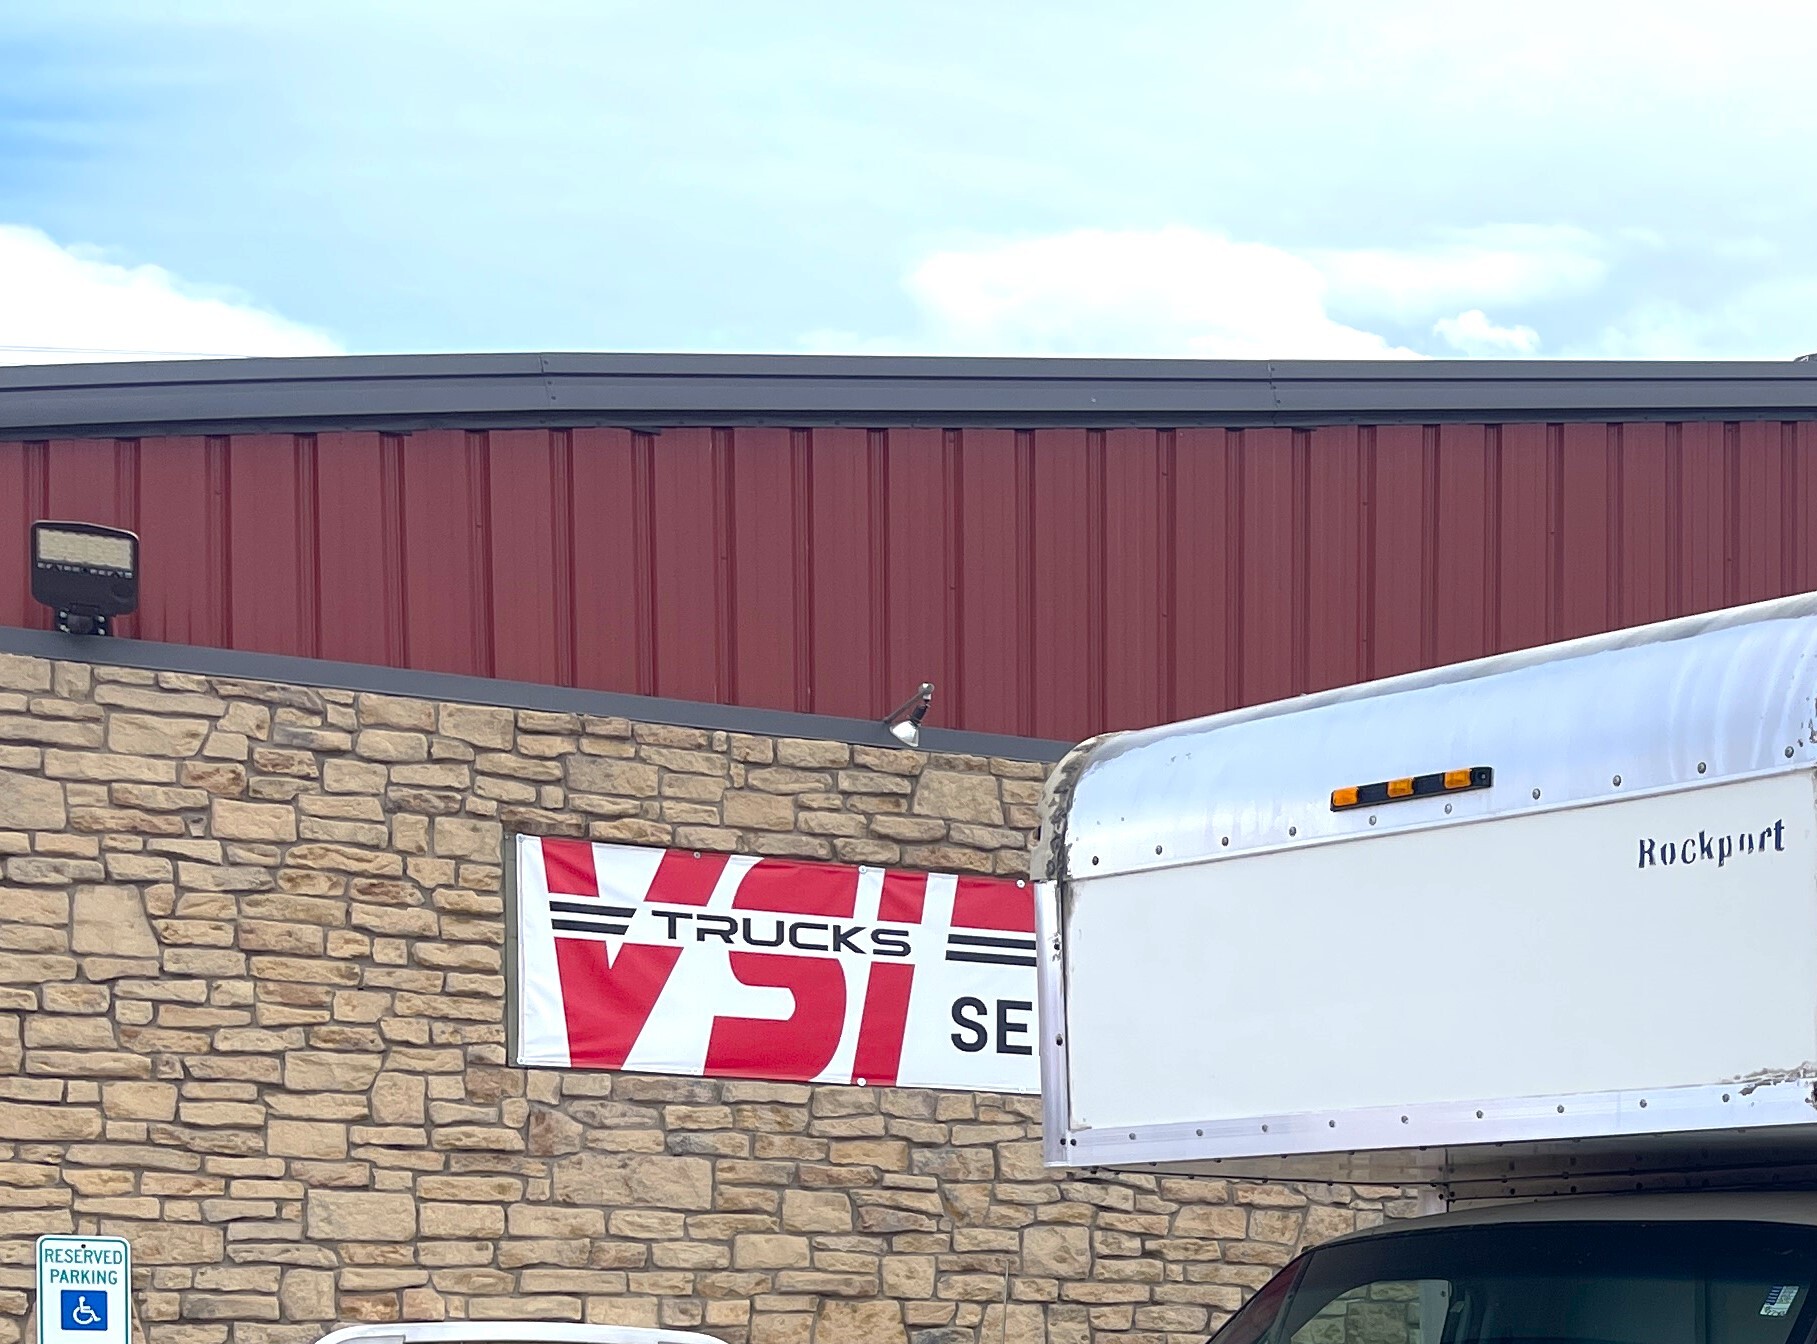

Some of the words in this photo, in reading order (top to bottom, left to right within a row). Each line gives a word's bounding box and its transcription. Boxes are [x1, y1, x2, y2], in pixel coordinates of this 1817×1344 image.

[1638, 818, 1785, 868] Rockport
[651, 909, 912, 958] TRUCKS
[541, 836, 928, 1088] VSI
[950, 996, 1040, 1056] SE
[44, 1248, 123, 1265] RESERVED
[50, 1268, 118, 1285] PARKING
